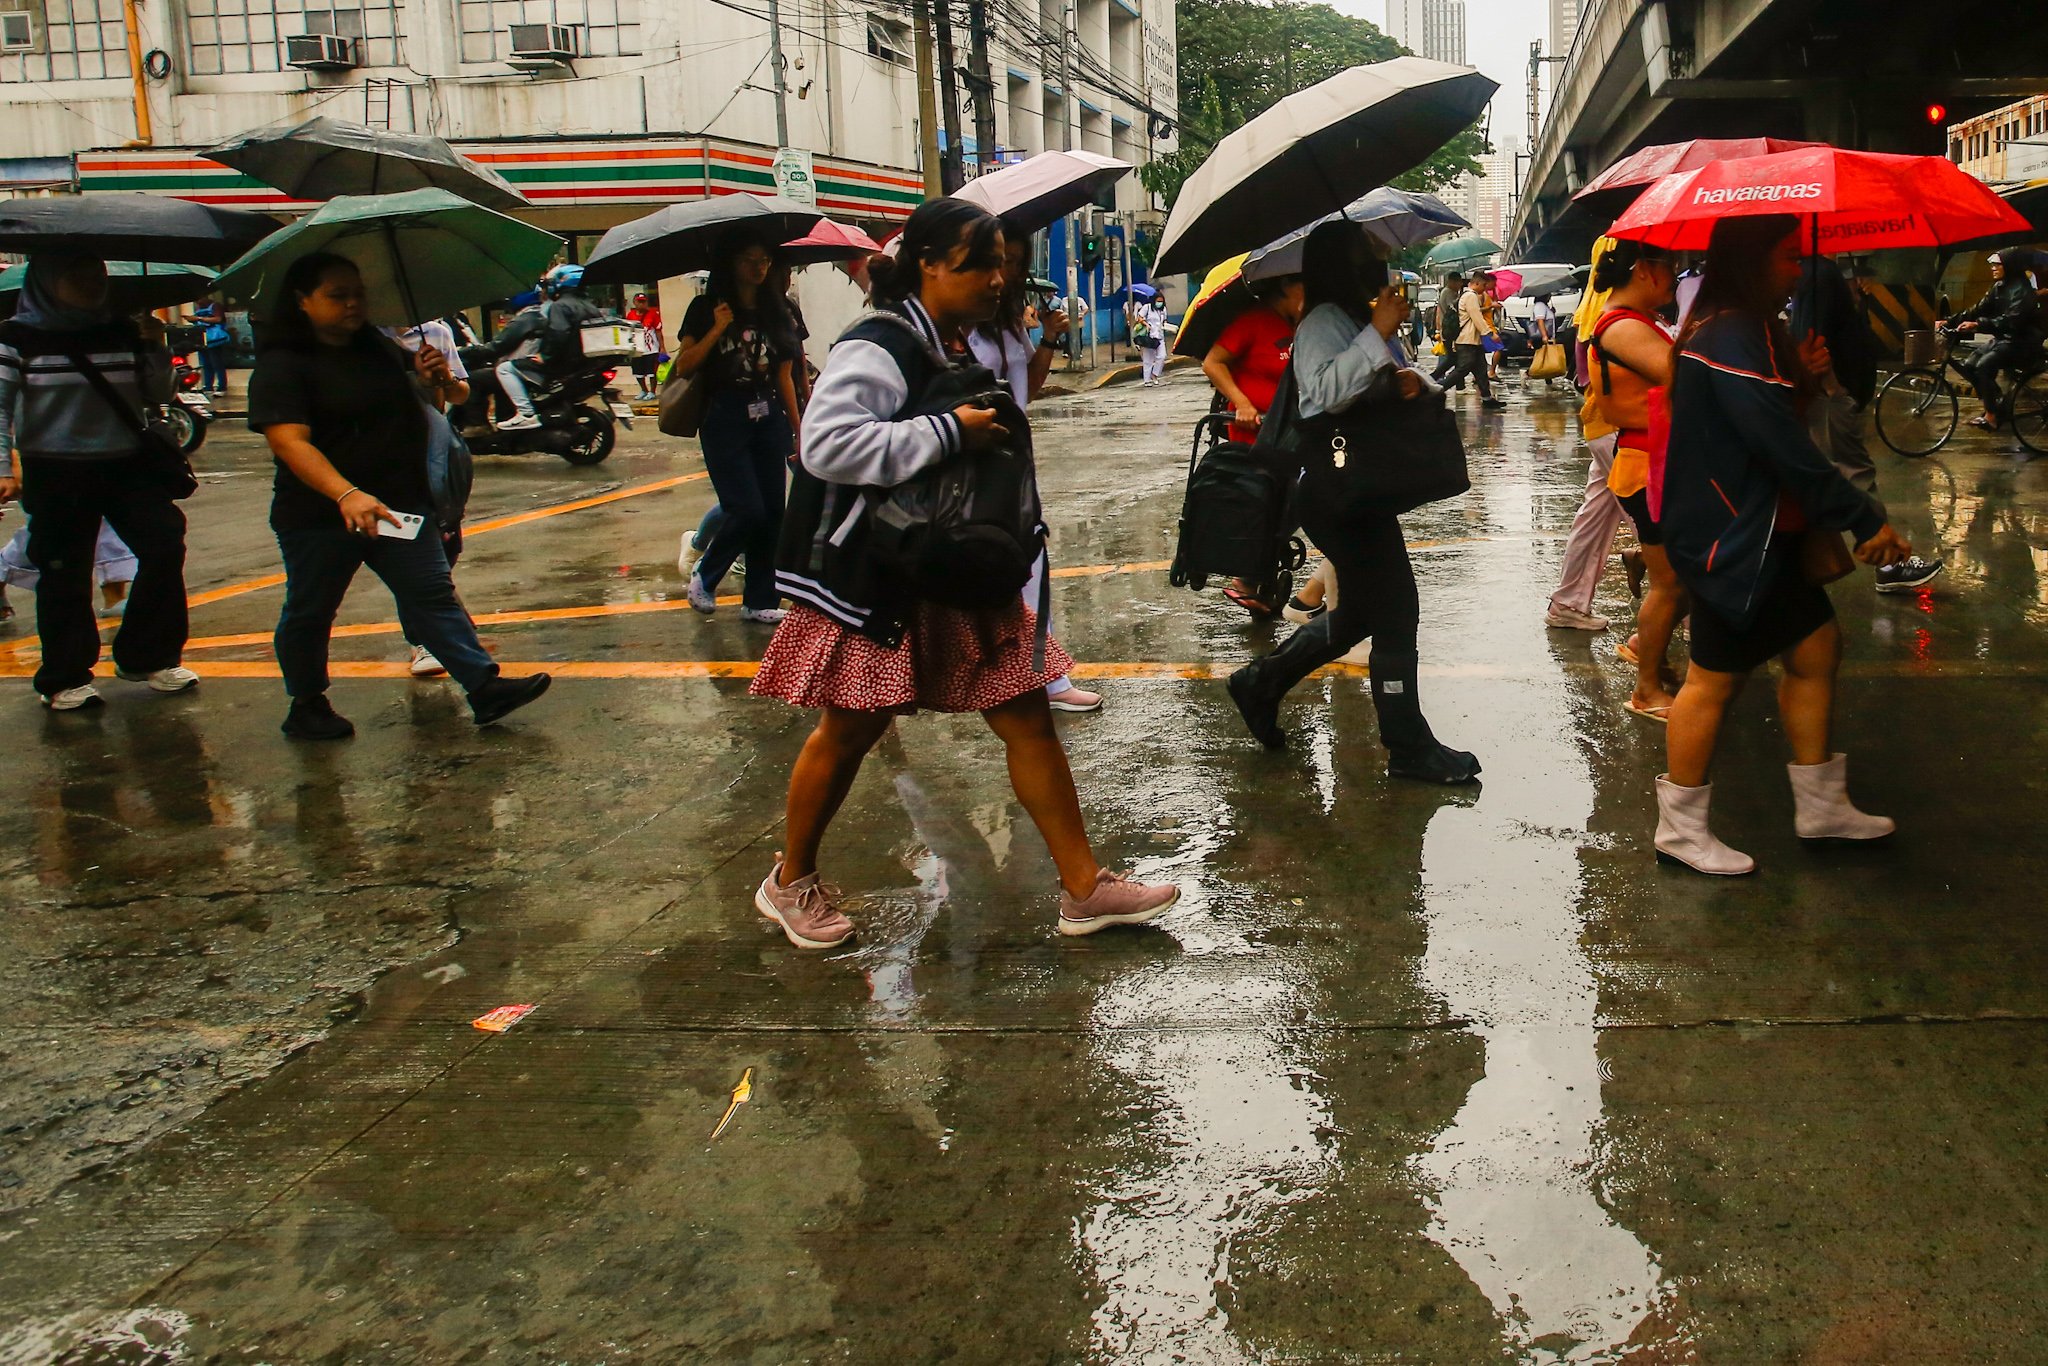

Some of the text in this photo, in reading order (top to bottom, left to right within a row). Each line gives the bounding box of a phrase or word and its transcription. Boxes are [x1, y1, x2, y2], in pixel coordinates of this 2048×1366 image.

[1144, 20, 1174, 57] Philippine
[1145, 44, 1173, 78] Christian
[1145, 66, 1175, 99] University
[1692, 181, 1822, 205] havaianas
